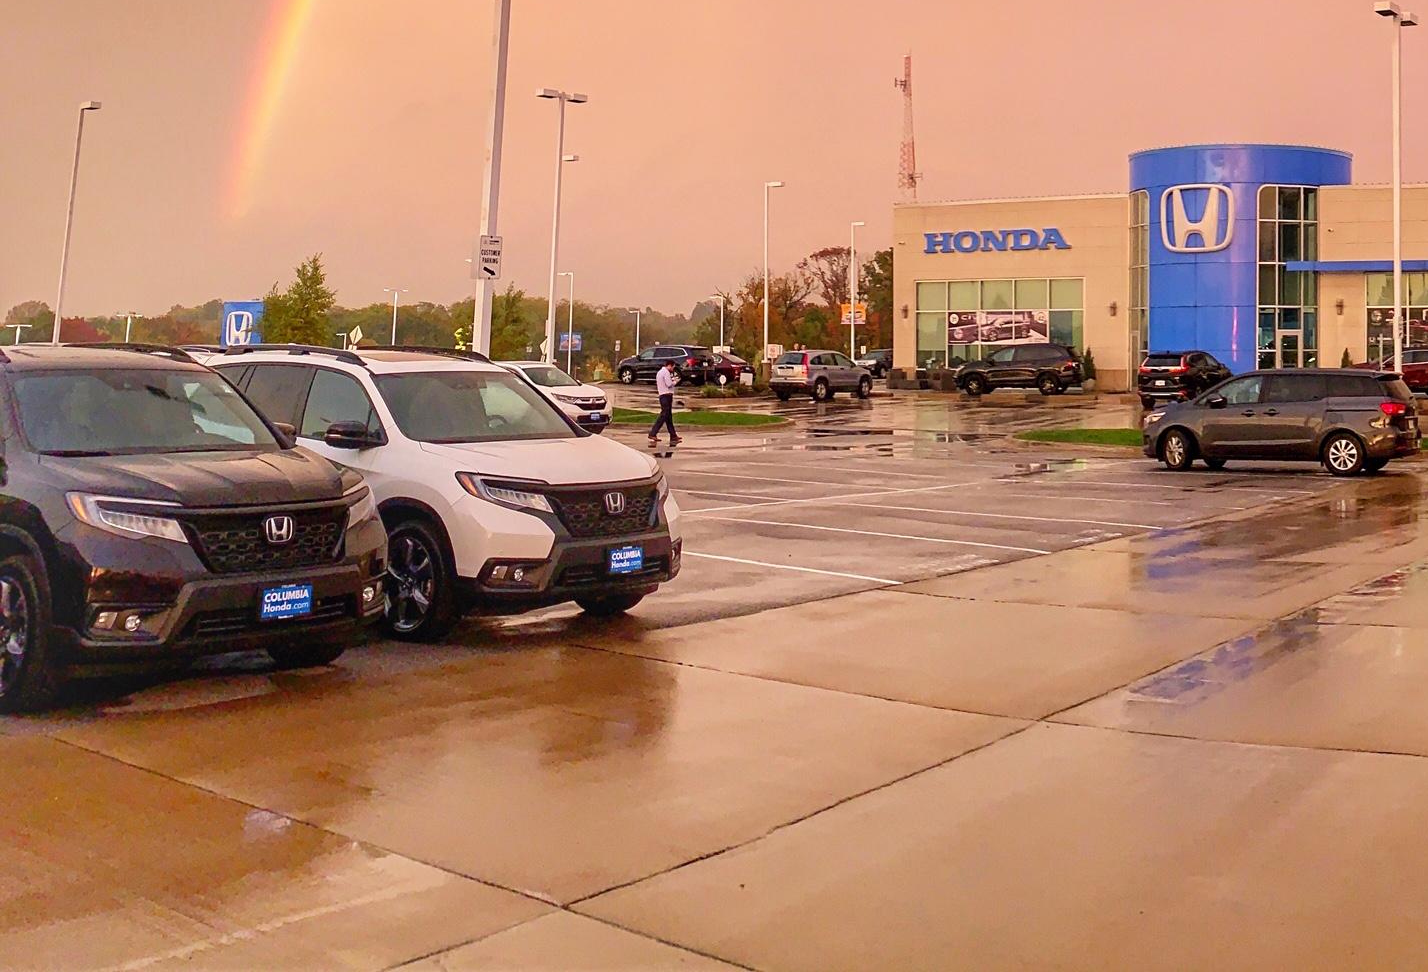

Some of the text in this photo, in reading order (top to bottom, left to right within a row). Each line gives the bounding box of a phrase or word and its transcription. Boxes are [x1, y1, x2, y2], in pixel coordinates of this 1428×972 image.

[924, 228, 1072, 254] HONDA
[481, 249, 501, 257] CUSTOMER
[611, 549, 641, 561] COLUMBIA
[264, 589, 309, 603] COLUMBIA
